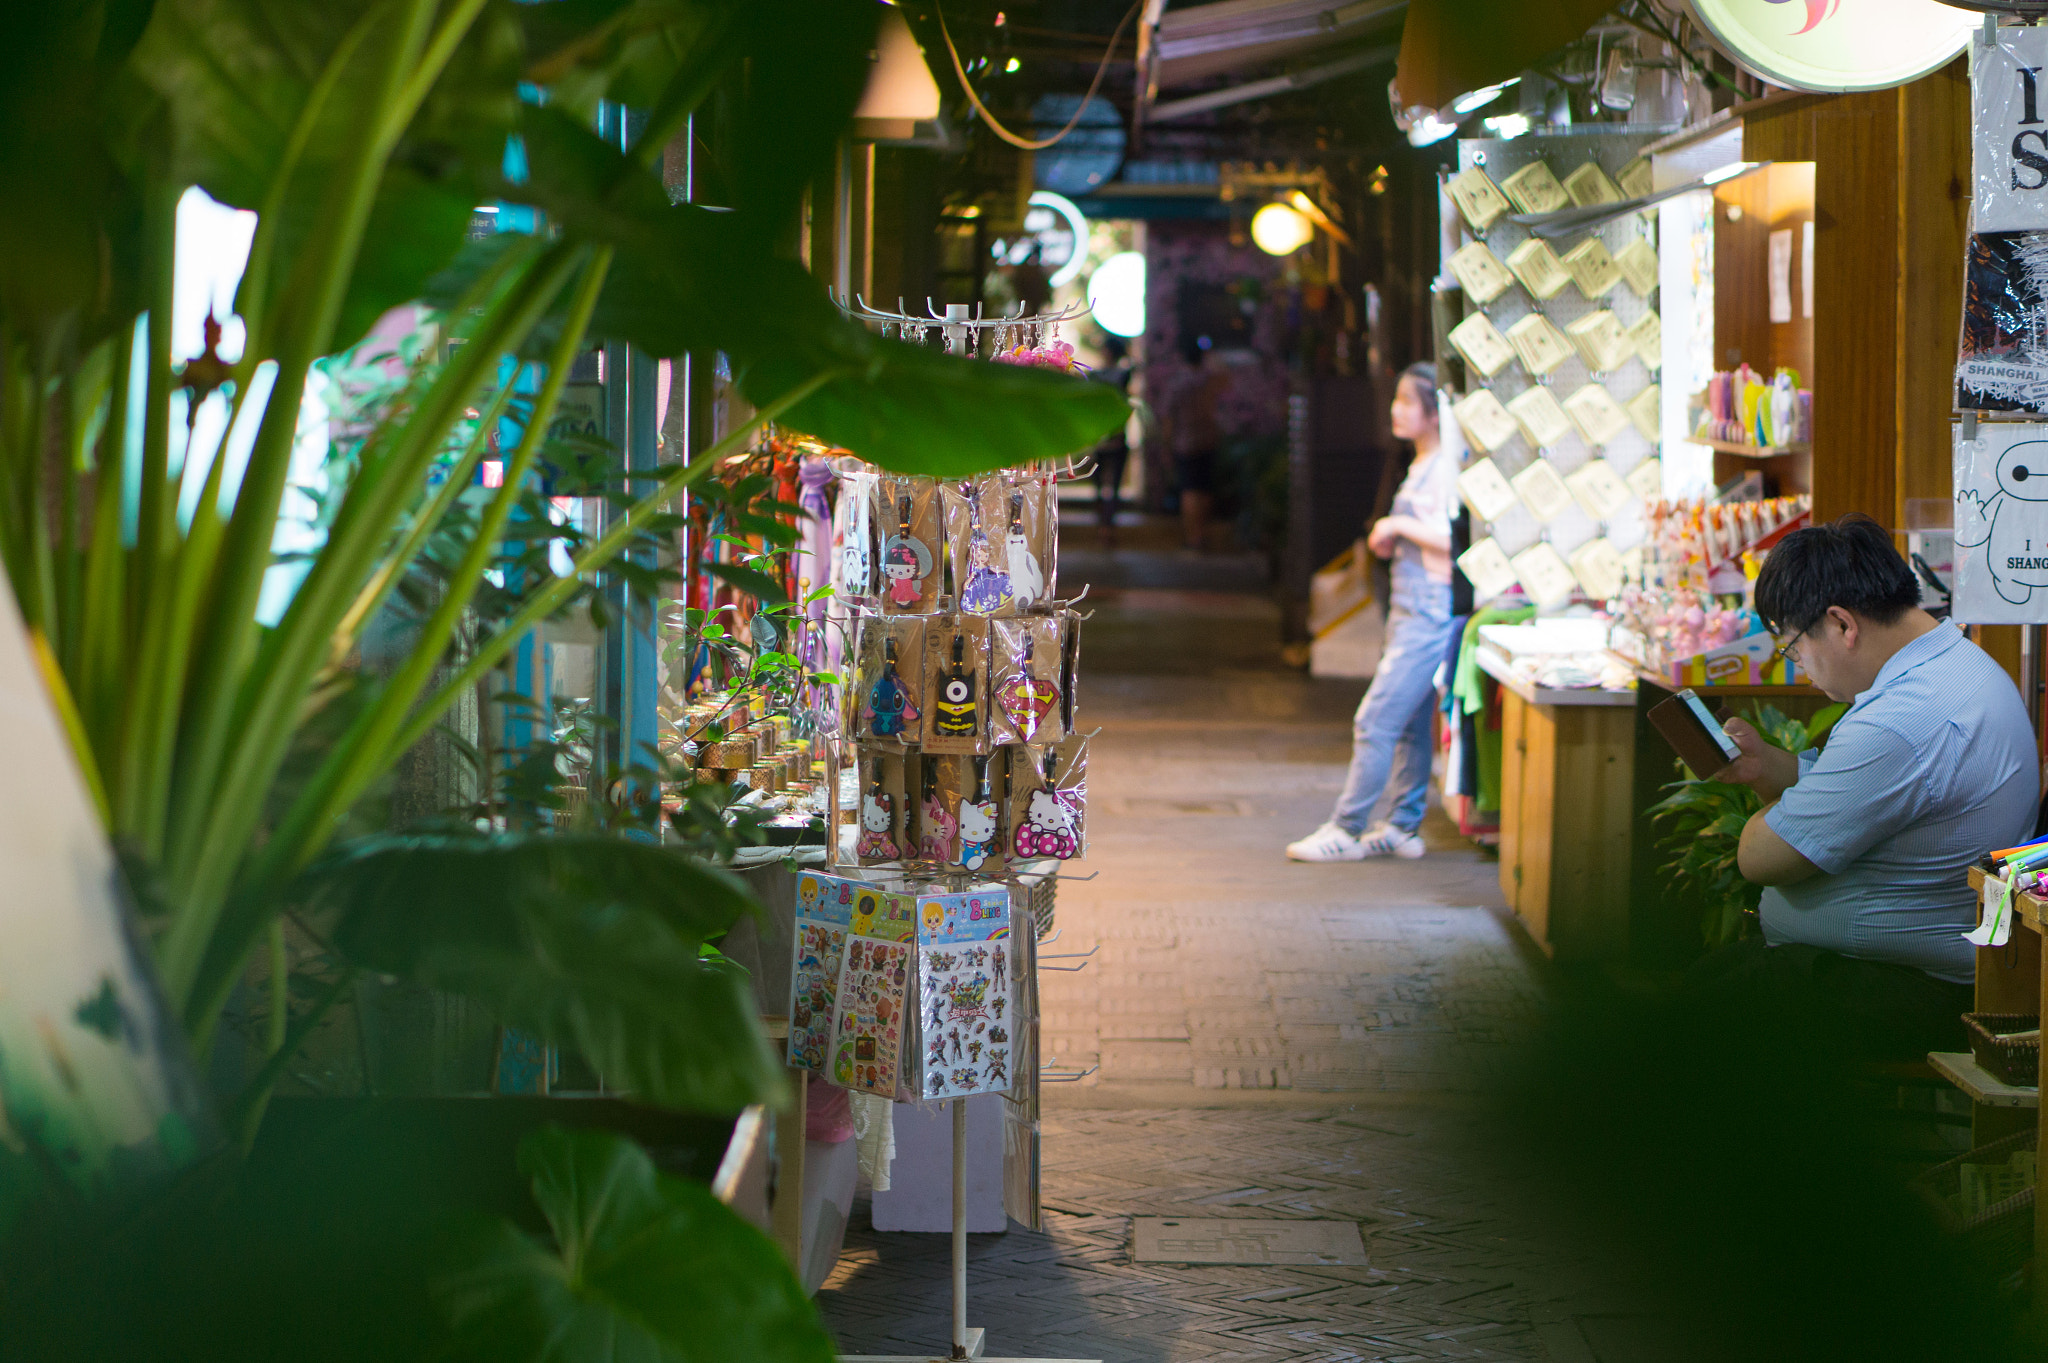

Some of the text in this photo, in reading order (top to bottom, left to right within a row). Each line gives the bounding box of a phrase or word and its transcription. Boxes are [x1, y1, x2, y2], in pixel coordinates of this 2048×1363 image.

[2016, 66, 2044, 125] I
[1968, 364, 2040, 381] SHANGHAI
[2025, 539, 2031, 551] I
[970, 899, 1001, 921] BLING
